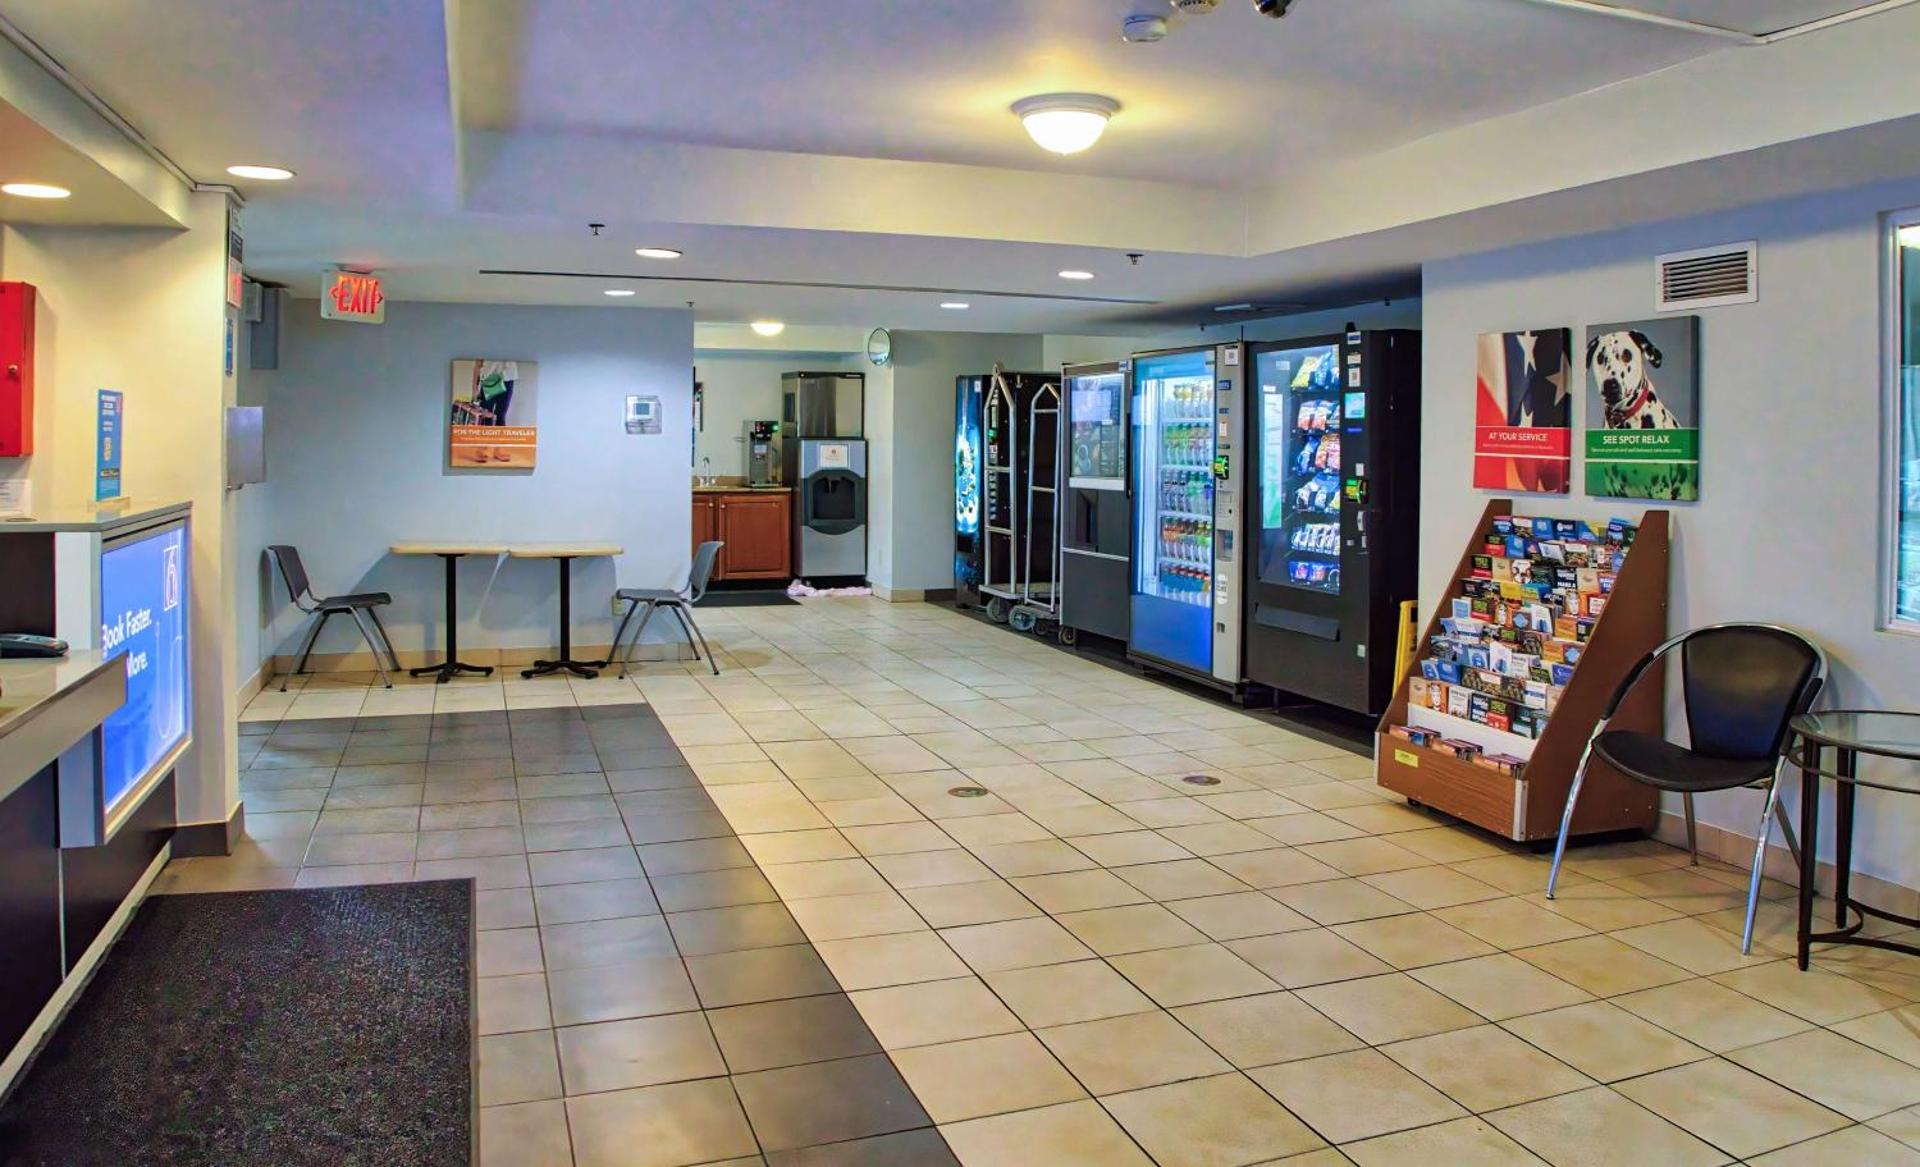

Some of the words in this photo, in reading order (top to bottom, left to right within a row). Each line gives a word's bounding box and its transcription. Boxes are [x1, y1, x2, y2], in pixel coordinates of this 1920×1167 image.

[337, 275, 379, 314] EXIT
[1488, 432, 1498, 440] AT
[1499, 432, 1517, 440] YOUR
[1518, 432, 1548, 442] SERVICE
[1603, 435, 1617, 444] SEE
[1619, 435, 1640, 444] SPOT
[1642, 435, 1670, 444] RELAX
[126, 608, 152, 638] Faster.
